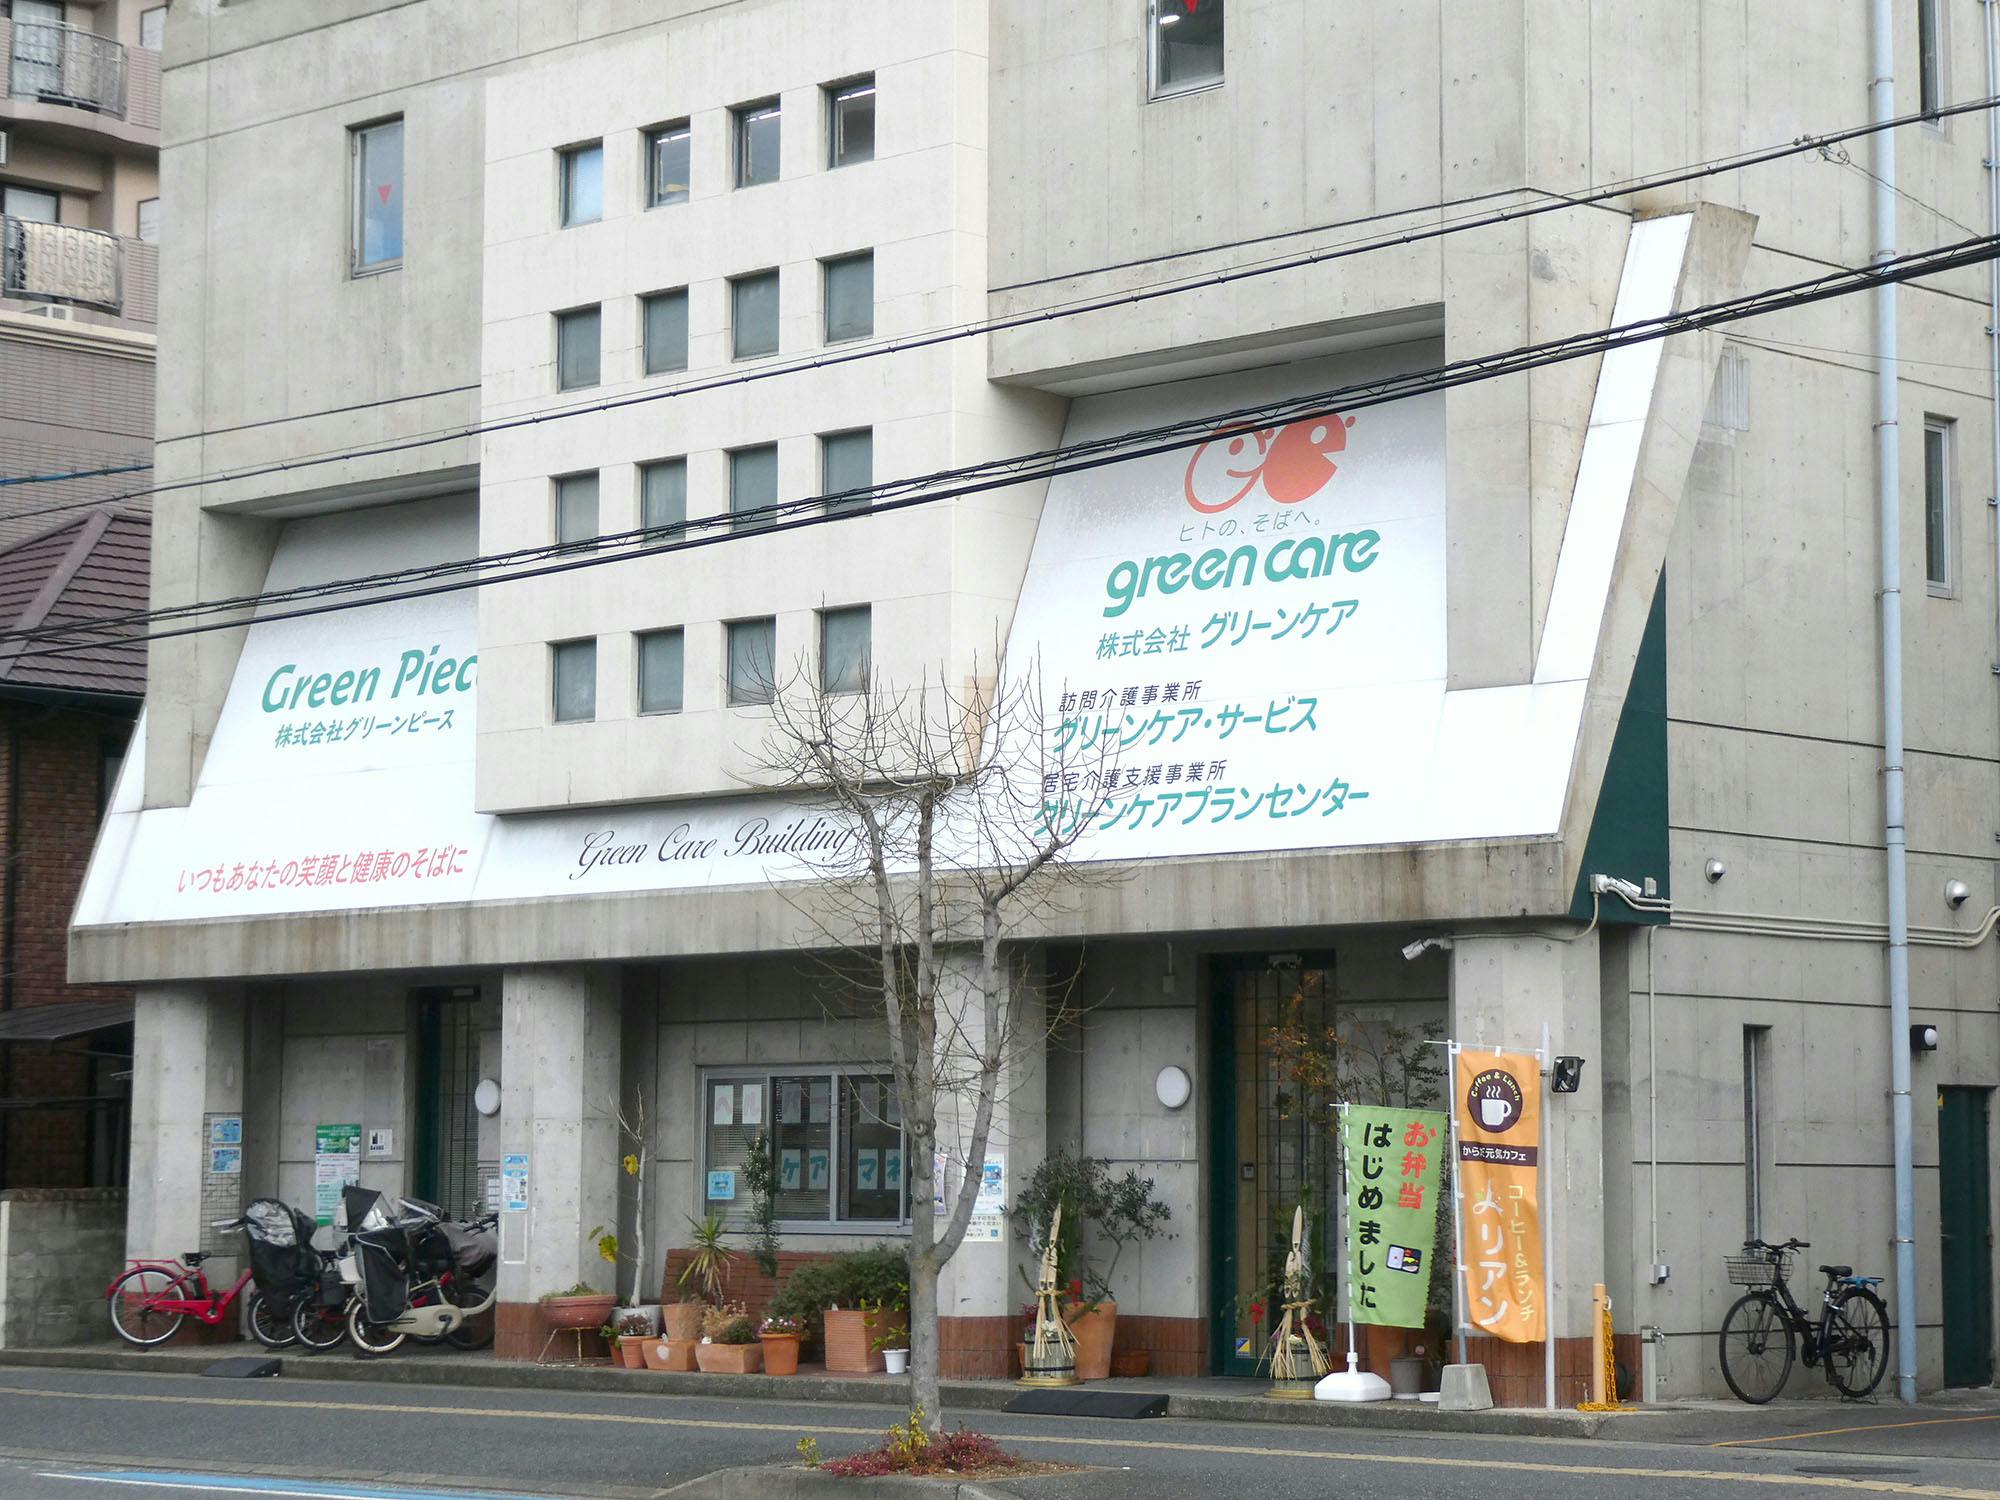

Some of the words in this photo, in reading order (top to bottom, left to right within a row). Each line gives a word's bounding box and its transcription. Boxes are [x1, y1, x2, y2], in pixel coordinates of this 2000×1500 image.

[1179, 510, 1321, 543] ヒトの、そばへ。
[1103, 545, 1257, 618] green
[1264, 529, 1381, 582] care
[1096, 625, 1191, 660] 株式会社
[1201, 600, 1359, 649] グリーンケア
[262, 663, 381, 714] Green
[390, 644, 478, 700] Piec
[1059, 680, 1203, 712] 訪問介護事業所
[275, 709, 455, 749] 株式会社グリーンピース
[1053, 696, 1318, 752] グリーンケア・サービス
[1043, 759, 1228, 794] 居宅介護支援事業所
[1034, 777, 1369, 837] グリーンケアプランセンター
[178, 844, 469, 893] いつもあなたの笑顔と健康のそばに
[569, 830, 649, 881] Green
[658, 823, 717, 863] Care
[724, 817, 853, 863] Building
[1471, 1073, 1492, 1097] Coffee
[1494, 1071, 1500, 1080] &
[1502, 1075, 1521, 1101] Lunch
[1398, 1121, 1436, 1210] お弁当
[1358, 1122, 1393, 1309] はじめました
